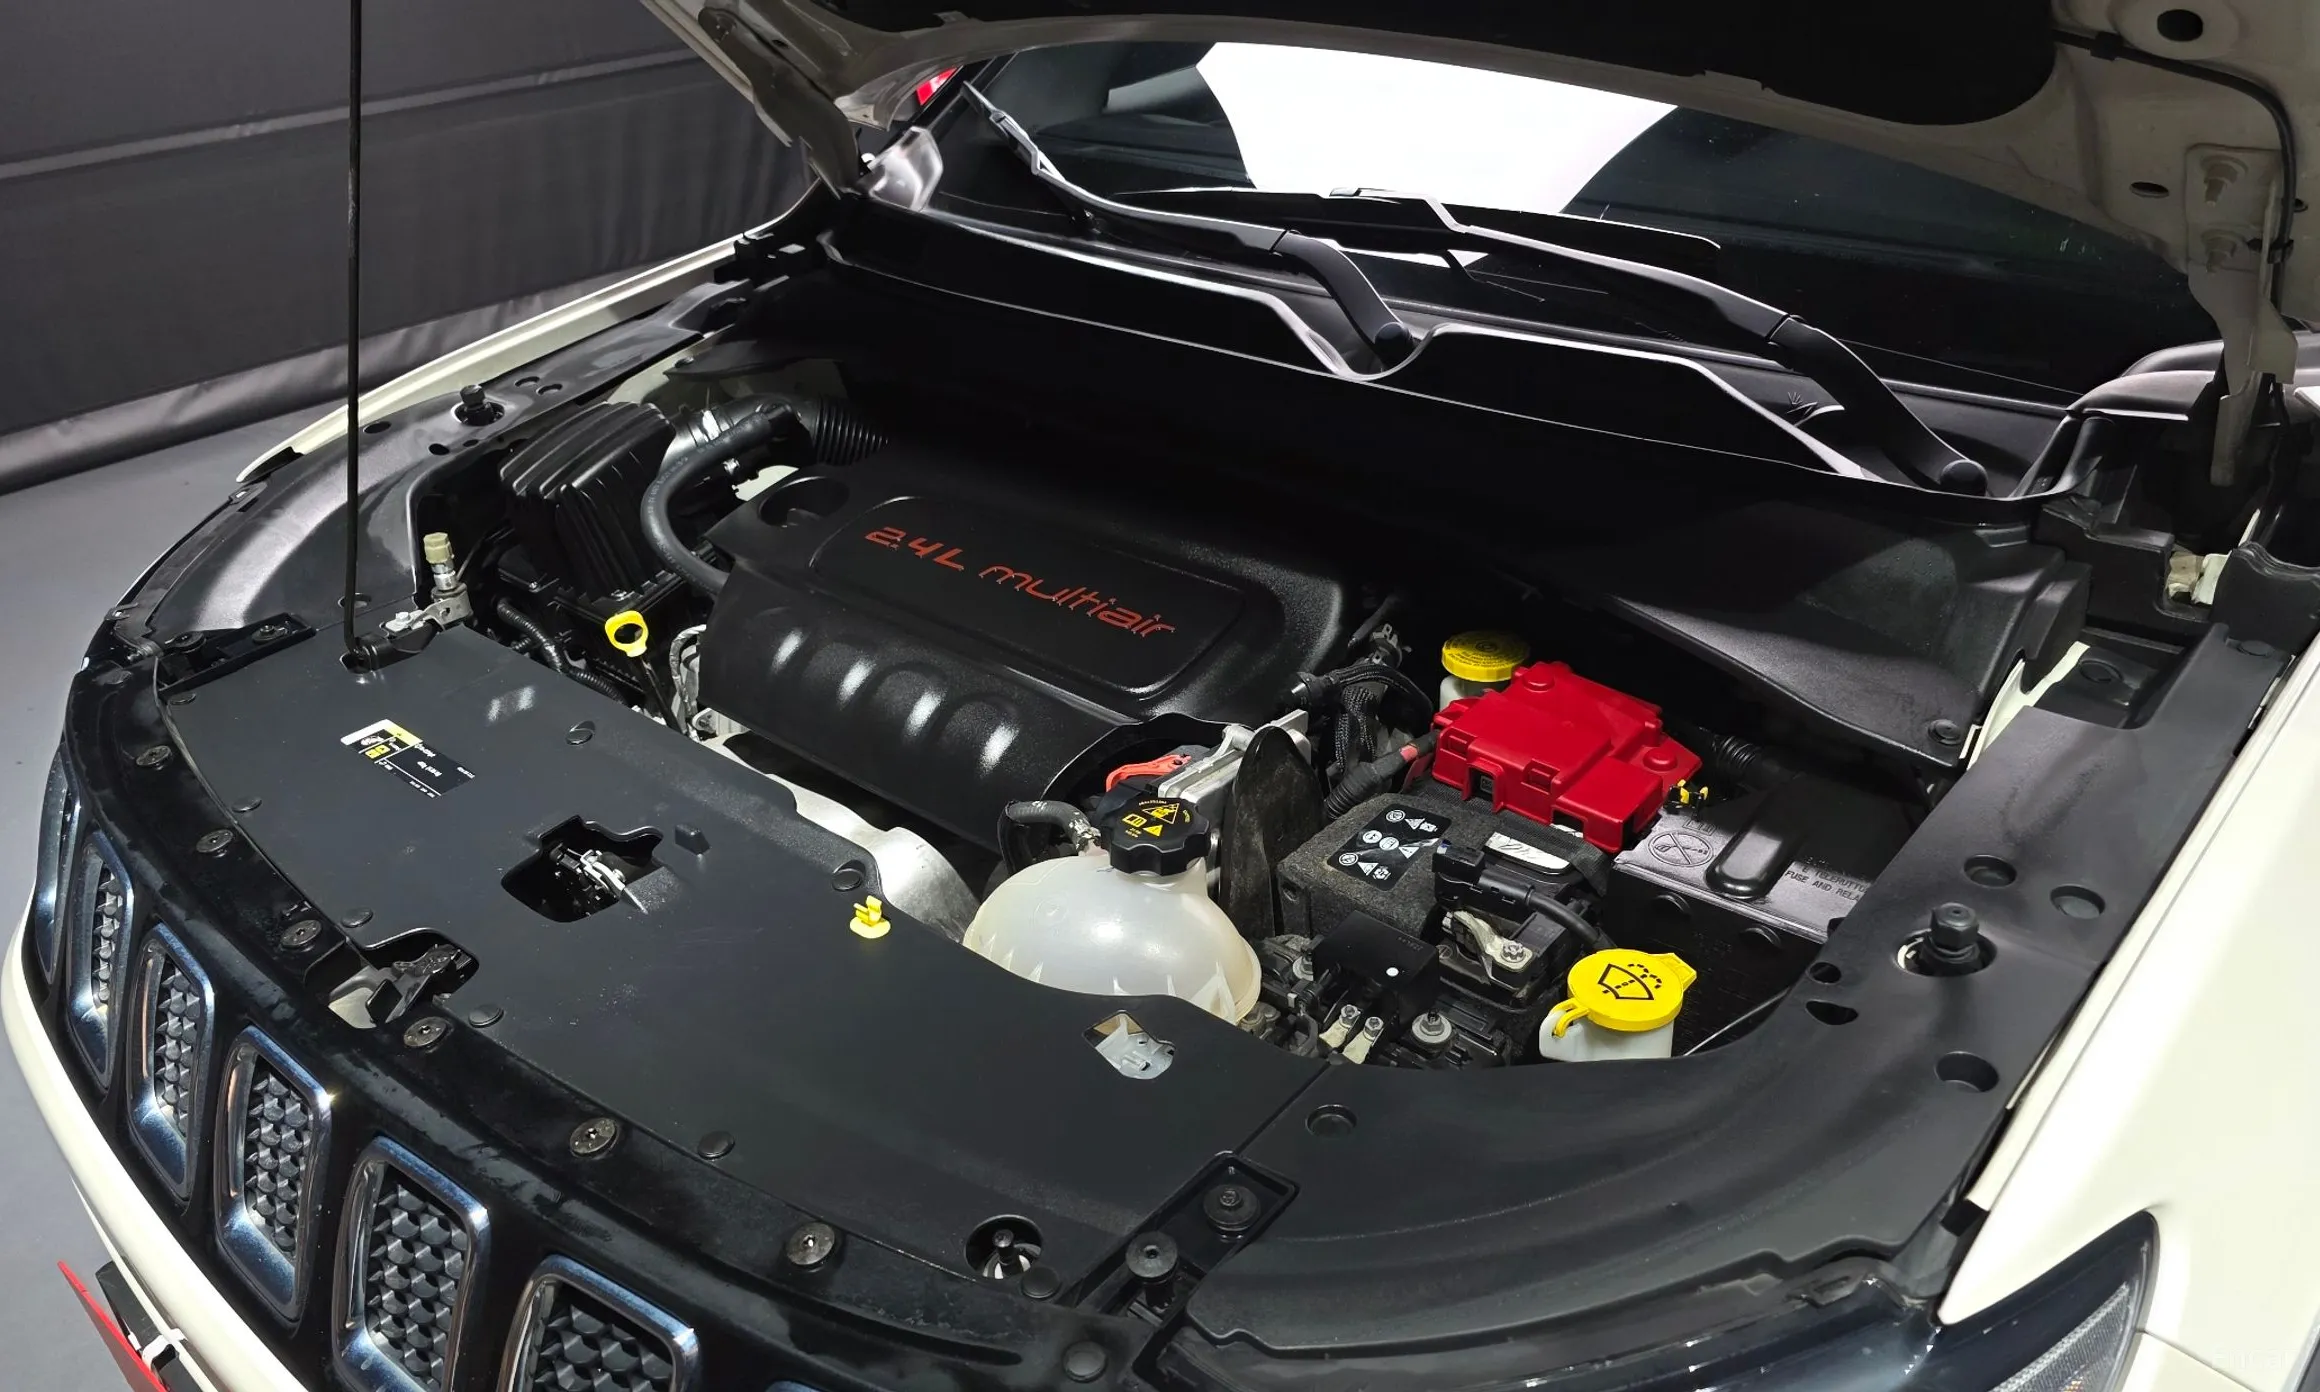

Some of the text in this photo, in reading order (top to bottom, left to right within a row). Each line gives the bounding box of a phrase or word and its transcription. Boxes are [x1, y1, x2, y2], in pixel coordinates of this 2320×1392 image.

[864, 525, 1177, 638] 2.4L multiair
[1784, 869, 1810, 883] FUSE
[1811, 880, 1832, 892] AND
[1814, 870, 1867, 893] TELERUTTO
